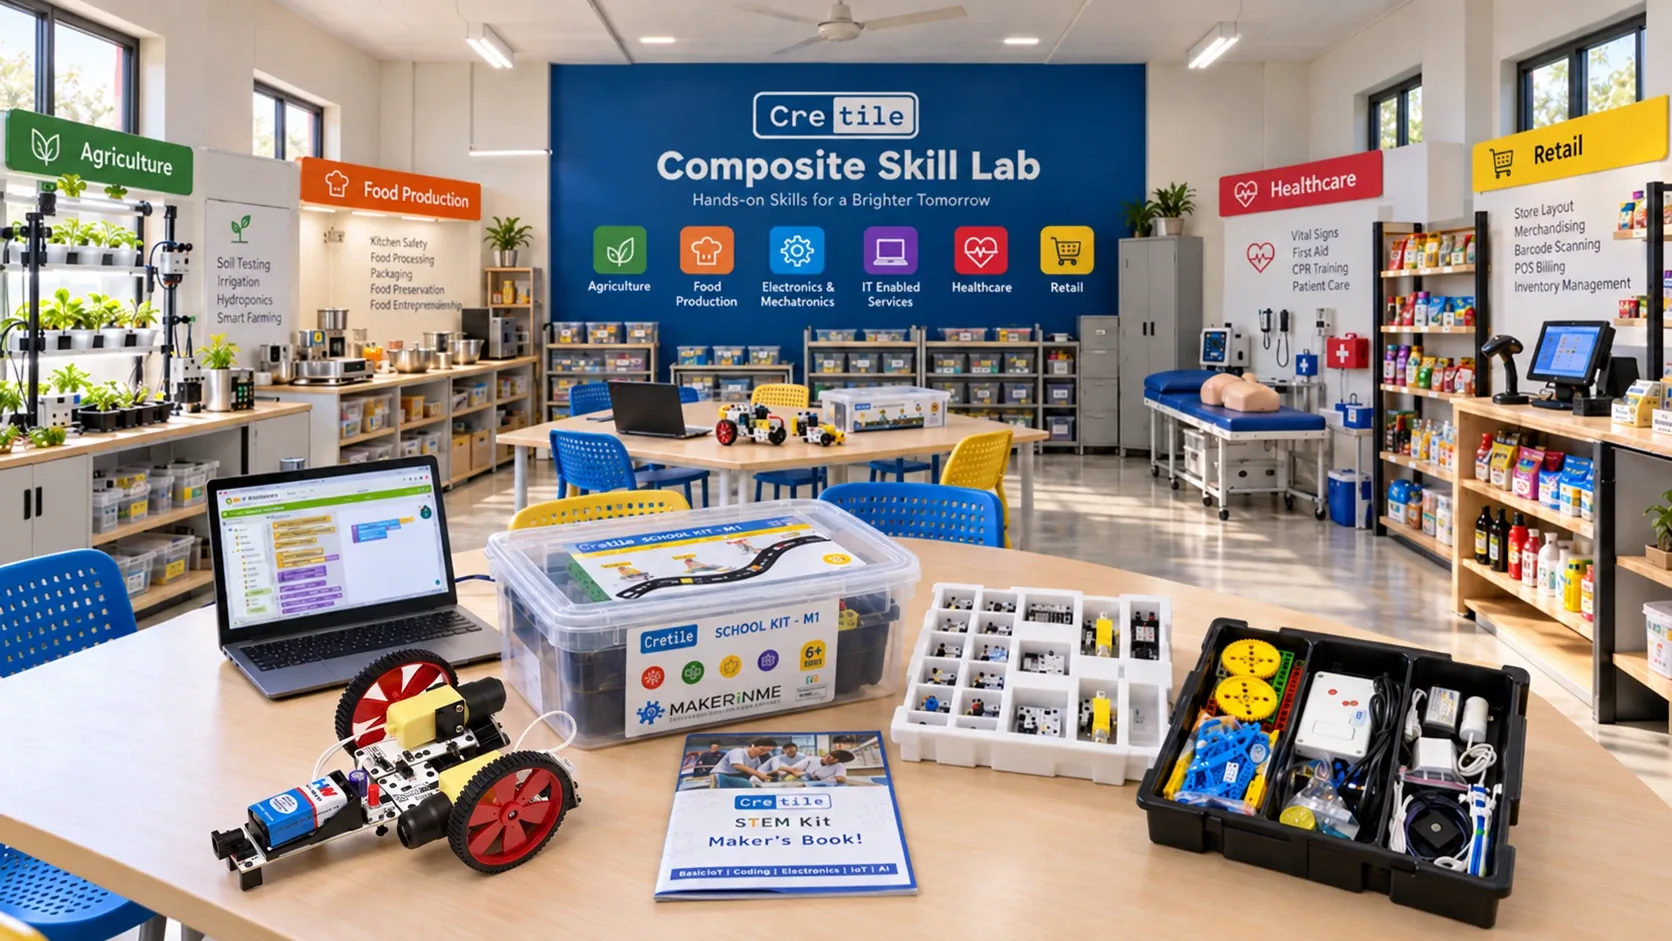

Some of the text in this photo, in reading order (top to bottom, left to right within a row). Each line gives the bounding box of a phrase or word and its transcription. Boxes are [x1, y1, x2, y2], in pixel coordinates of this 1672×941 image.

[1534, 134, 1583, 165] Retail
[80, 141, 173, 176] Agriculture
[657, 149, 1041, 188] Composite Skill Lab
[1271, 173, 1357, 198] Healthcare
[364, 181, 469, 208] Food Production
[692, 192, 991, 210] Hands-on Skills for a Brighter Tomorrow
[1514, 200, 1574, 219] Store Layout
[1291, 228, 1339, 242] Vital Signs
[1514, 219, 1586, 238] Merchandising
[370, 236, 428, 251] Kitchen Safety
[1514, 238, 1601, 256] Barcode Scanning
[1293, 245, 1329, 258] First Aid
[217, 256, 271, 273] Soil Testing
[370, 252, 435, 267] Food Processing
[1292, 261, 1349, 276] CPR Training
[1514, 260, 1566, 275] POS Billing
[217, 274, 260, 290] Irrigation
[370, 268, 413, 282] Packaging
[370, 283, 445, 295] Food Preservation
[587, 280, 652, 294] Agriculture
[693, 281, 722, 292] Food
[762, 281, 836, 292] Electronics &
[861, 281, 921, 292] IT Enabled
[952, 281, 1013, 293] Healthcare
[1050, 281, 1084, 292] Retail
[1293, 279, 1351, 292] Patient Care
[1514, 277, 1631, 294] Inventory Management
[217, 293, 273, 308] Hydroponics
[370, 299, 391, 310] Food
[676, 295, 738, 307] Production
[760, 295, 836, 307] Mechatronics
[867, 296, 914, 307] Services
[217, 311, 282, 326] Smart Farming
[644, 630, 694, 649] Cretile
[715, 620, 766, 639] SCHOOL
[770, 616, 791, 631] KIT
[803, 612, 820, 625] M1
[805, 645, 822, 659] 6+
[735, 816, 831, 828] STEM Kit
[709, 833, 862, 847] Maker's Book!
[733, 868, 770, 876] Coding
[781, 866, 840, 875] Electronics
